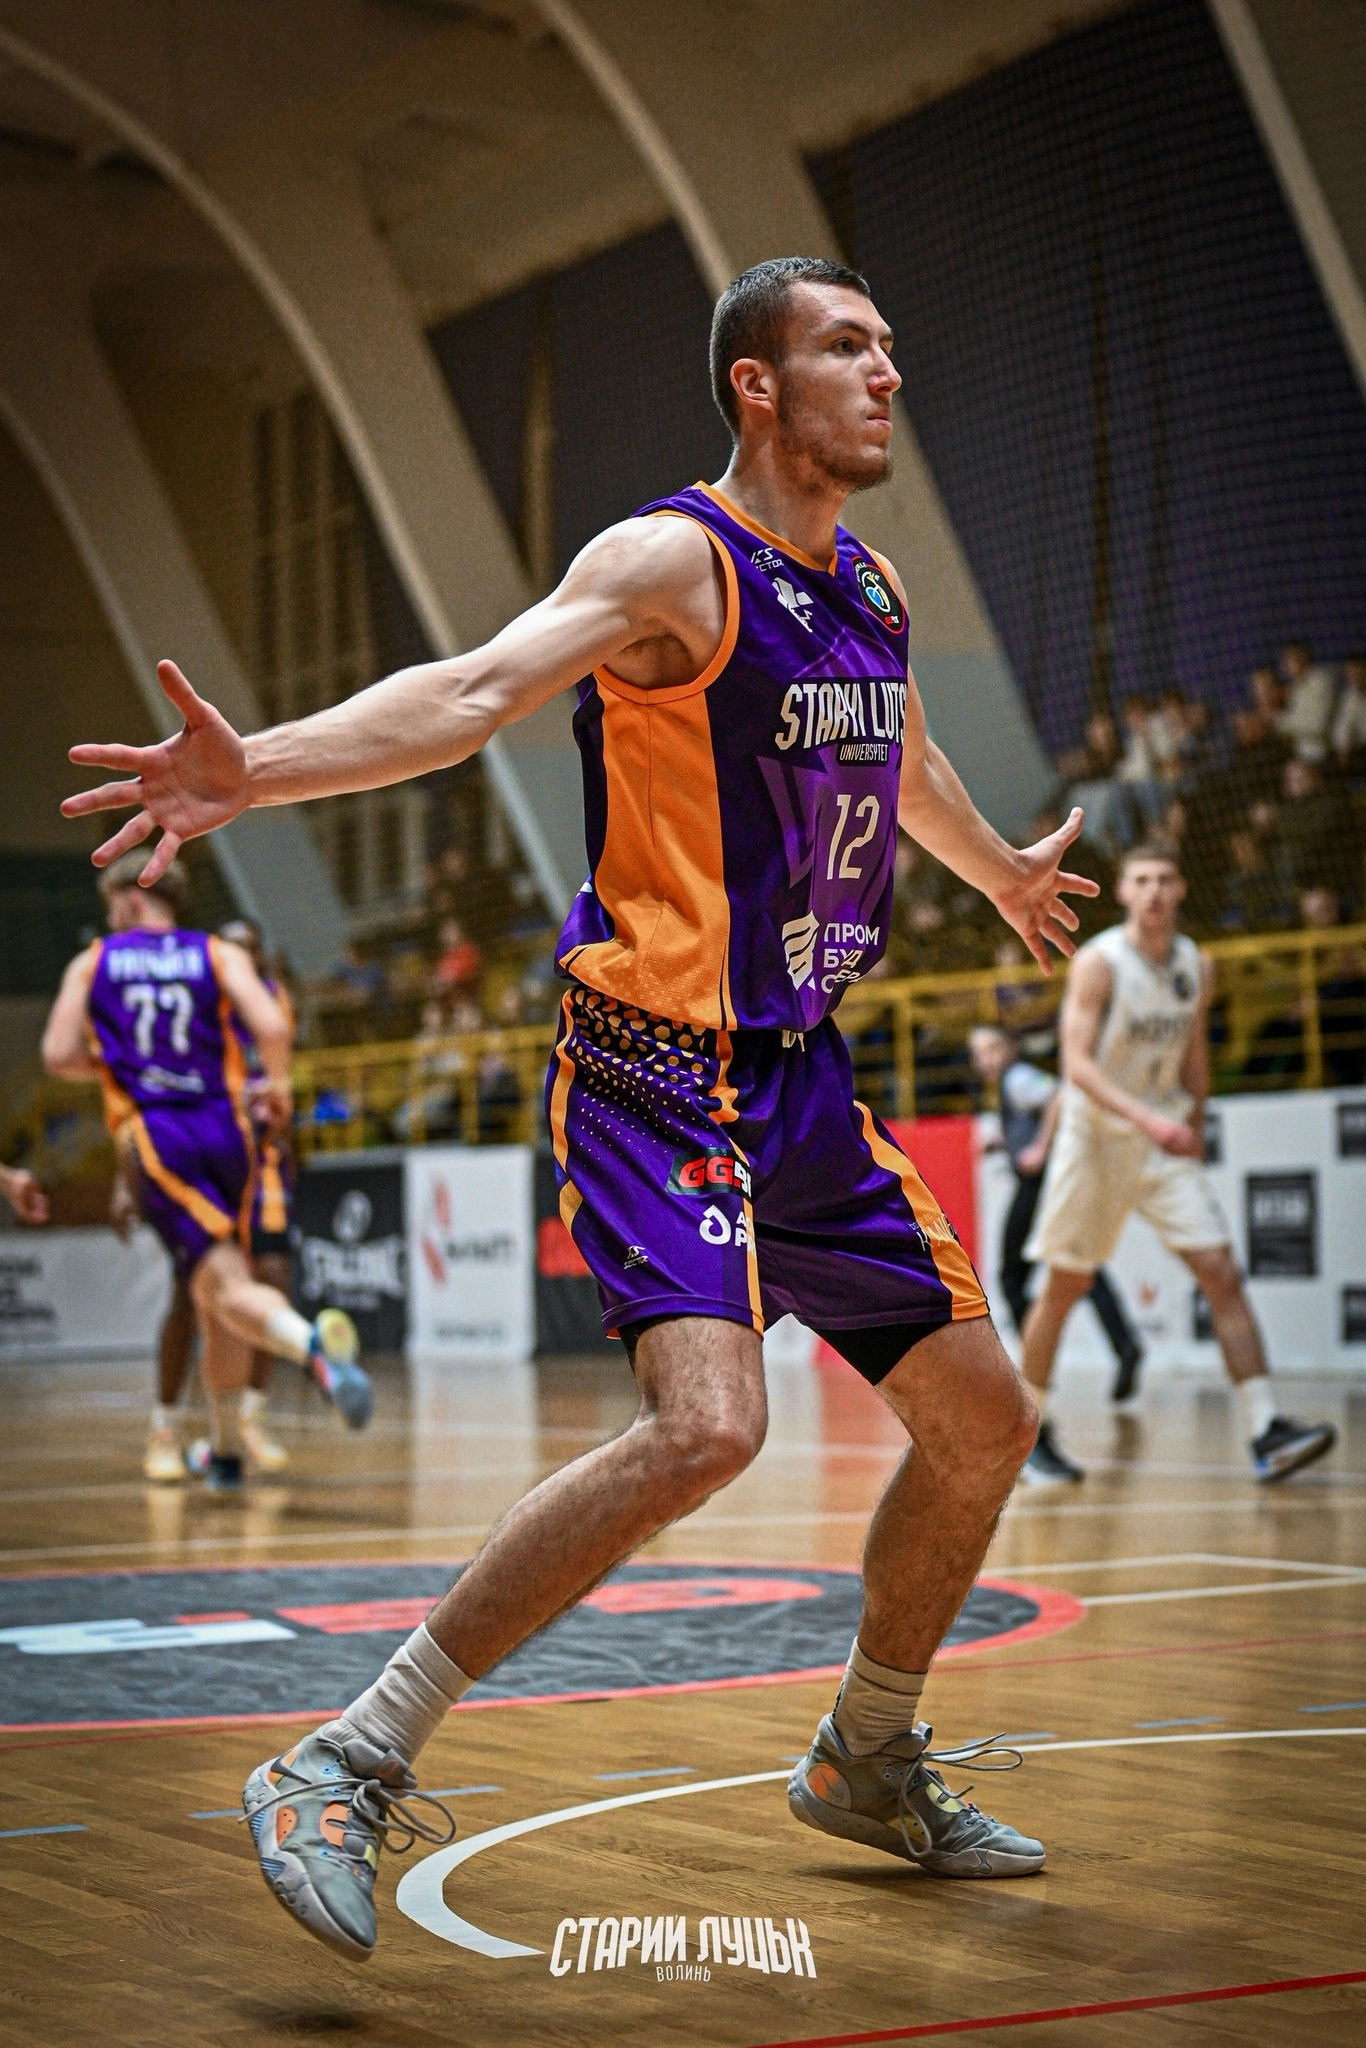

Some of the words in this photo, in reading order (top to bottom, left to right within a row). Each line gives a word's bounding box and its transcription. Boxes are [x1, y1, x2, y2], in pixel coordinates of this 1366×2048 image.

[839, 743, 888, 761] UNIVERSYTET
[826, 794, 880, 881] 12
[824, 922, 880, 946] ПРОМ
[823, 948, 864, 969] БУД
